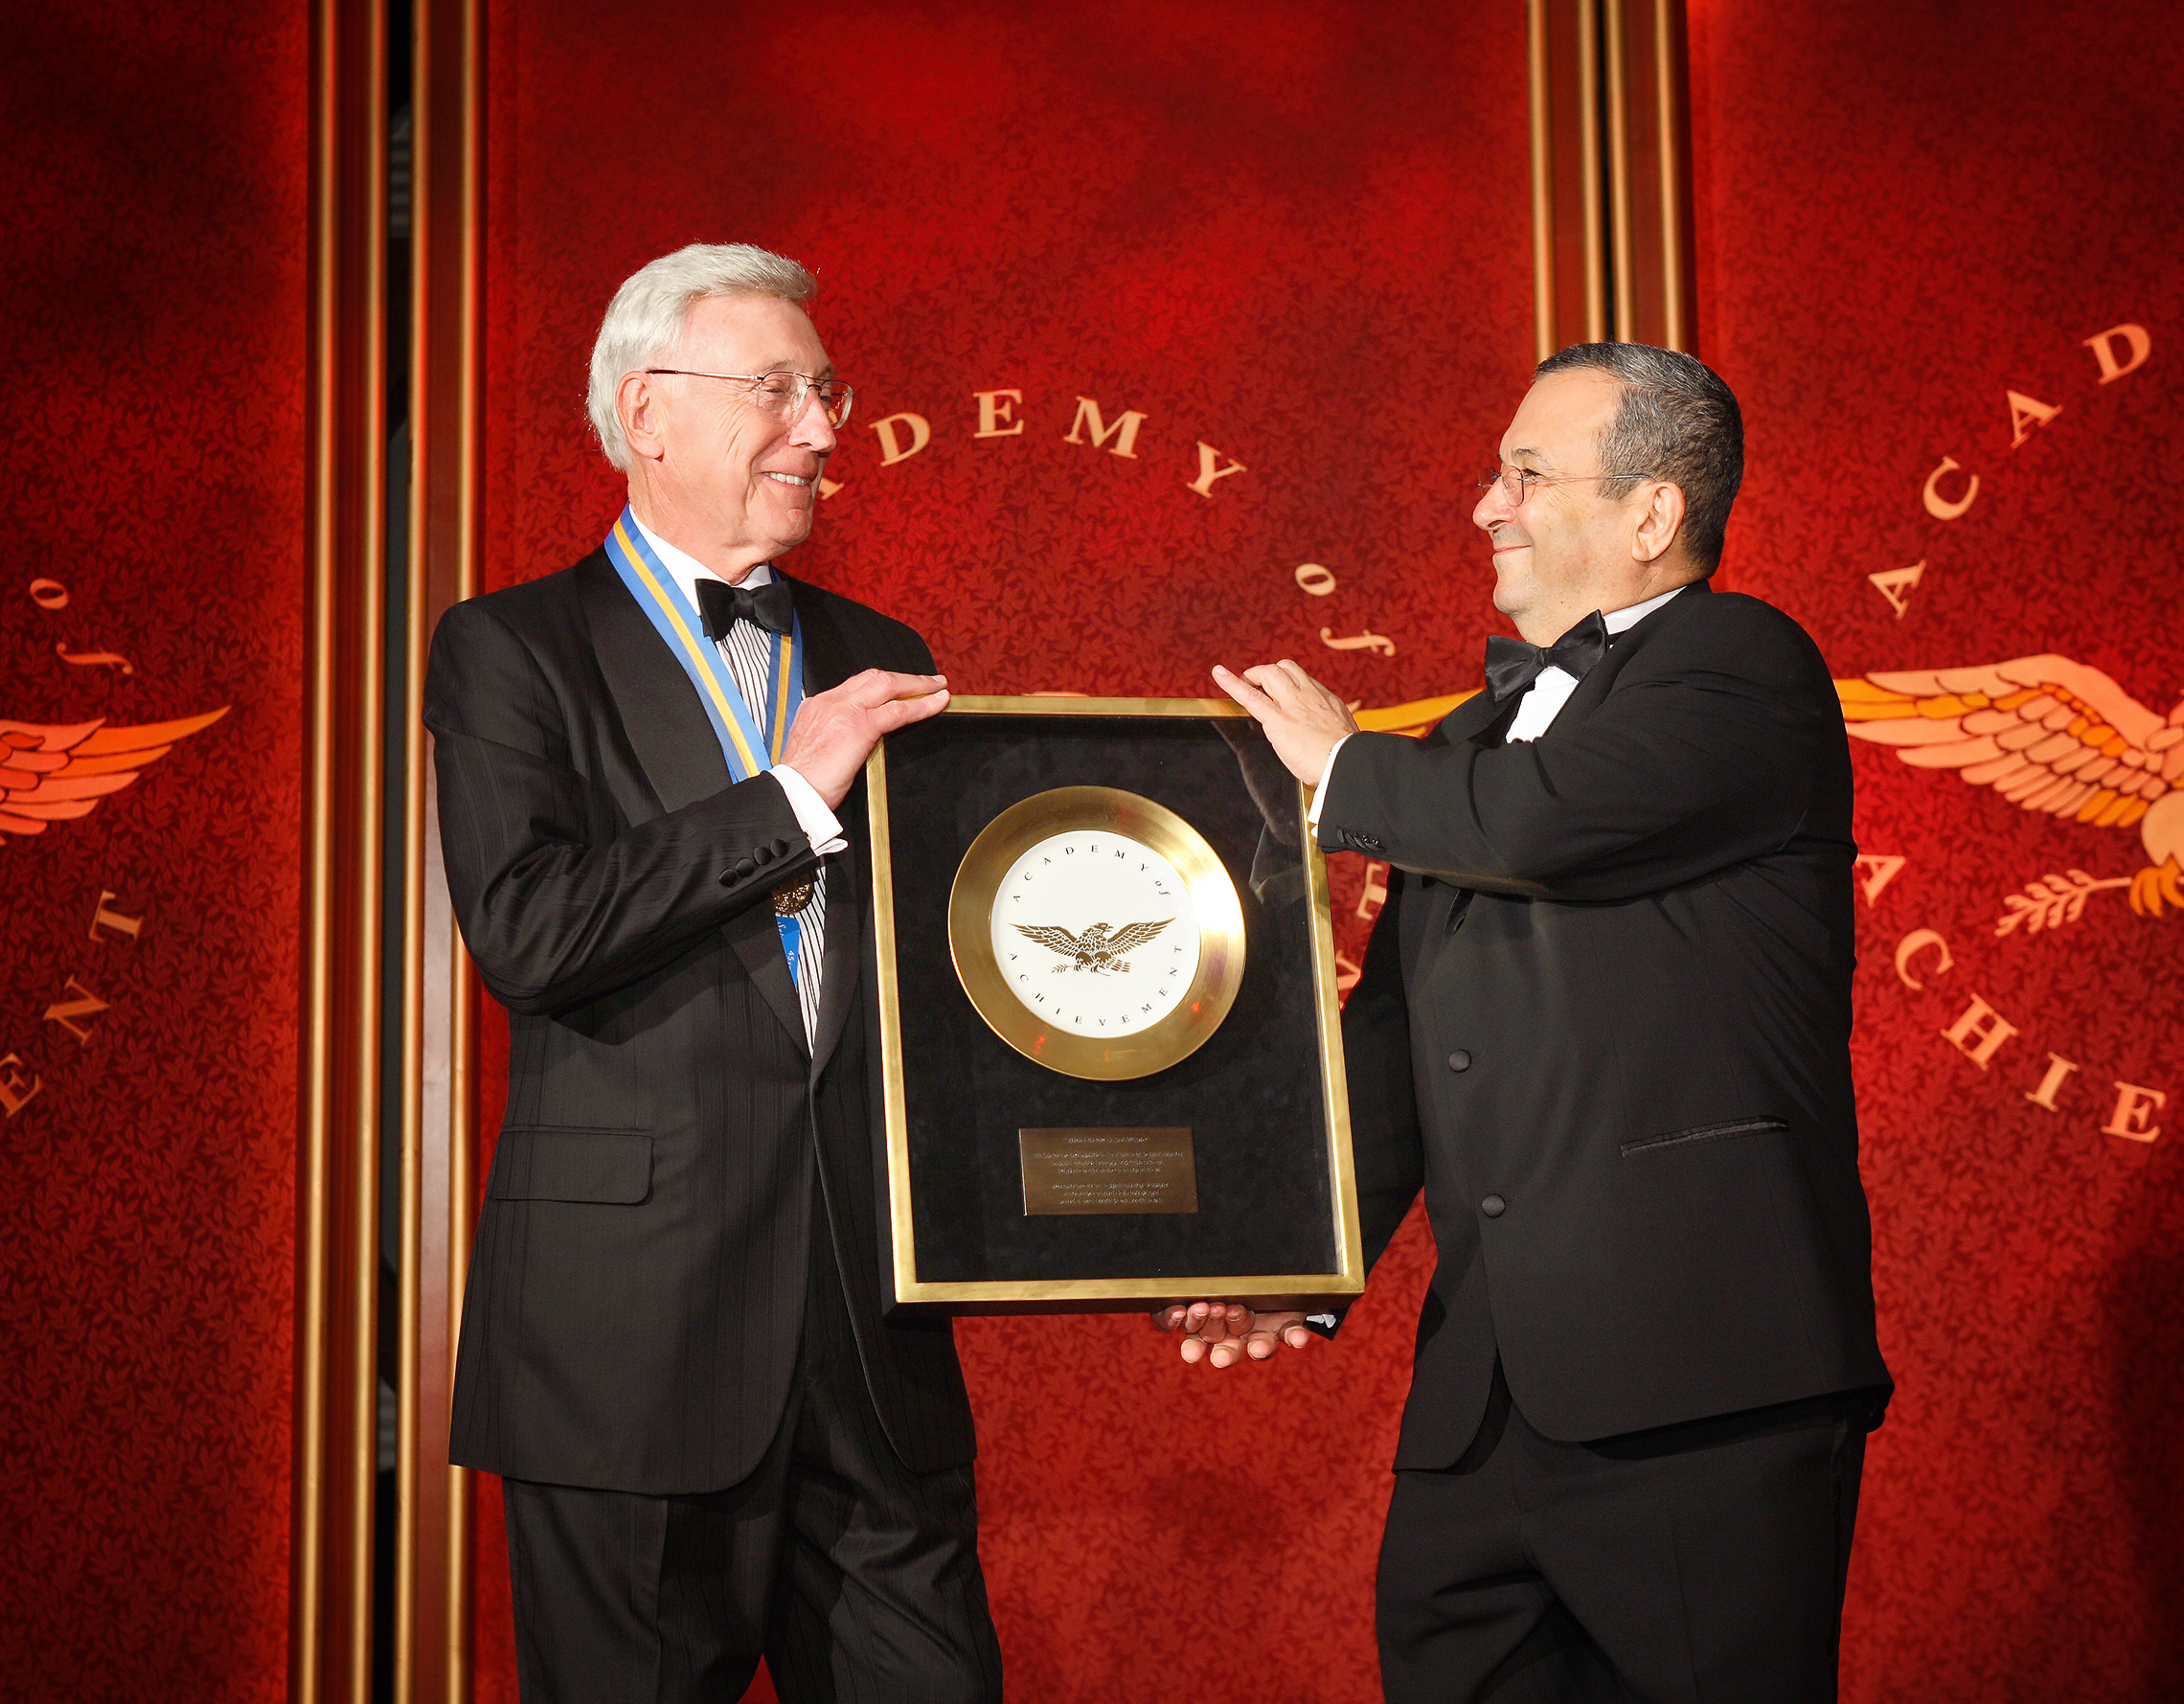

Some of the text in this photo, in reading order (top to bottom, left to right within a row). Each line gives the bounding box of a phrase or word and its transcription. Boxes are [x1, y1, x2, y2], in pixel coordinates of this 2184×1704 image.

[1293, 562, 1396, 657] of
[1012, 844, 1171, 903] ACADEMY of
[1010, 944, 1183, 1028] ACHIEVEMENT
